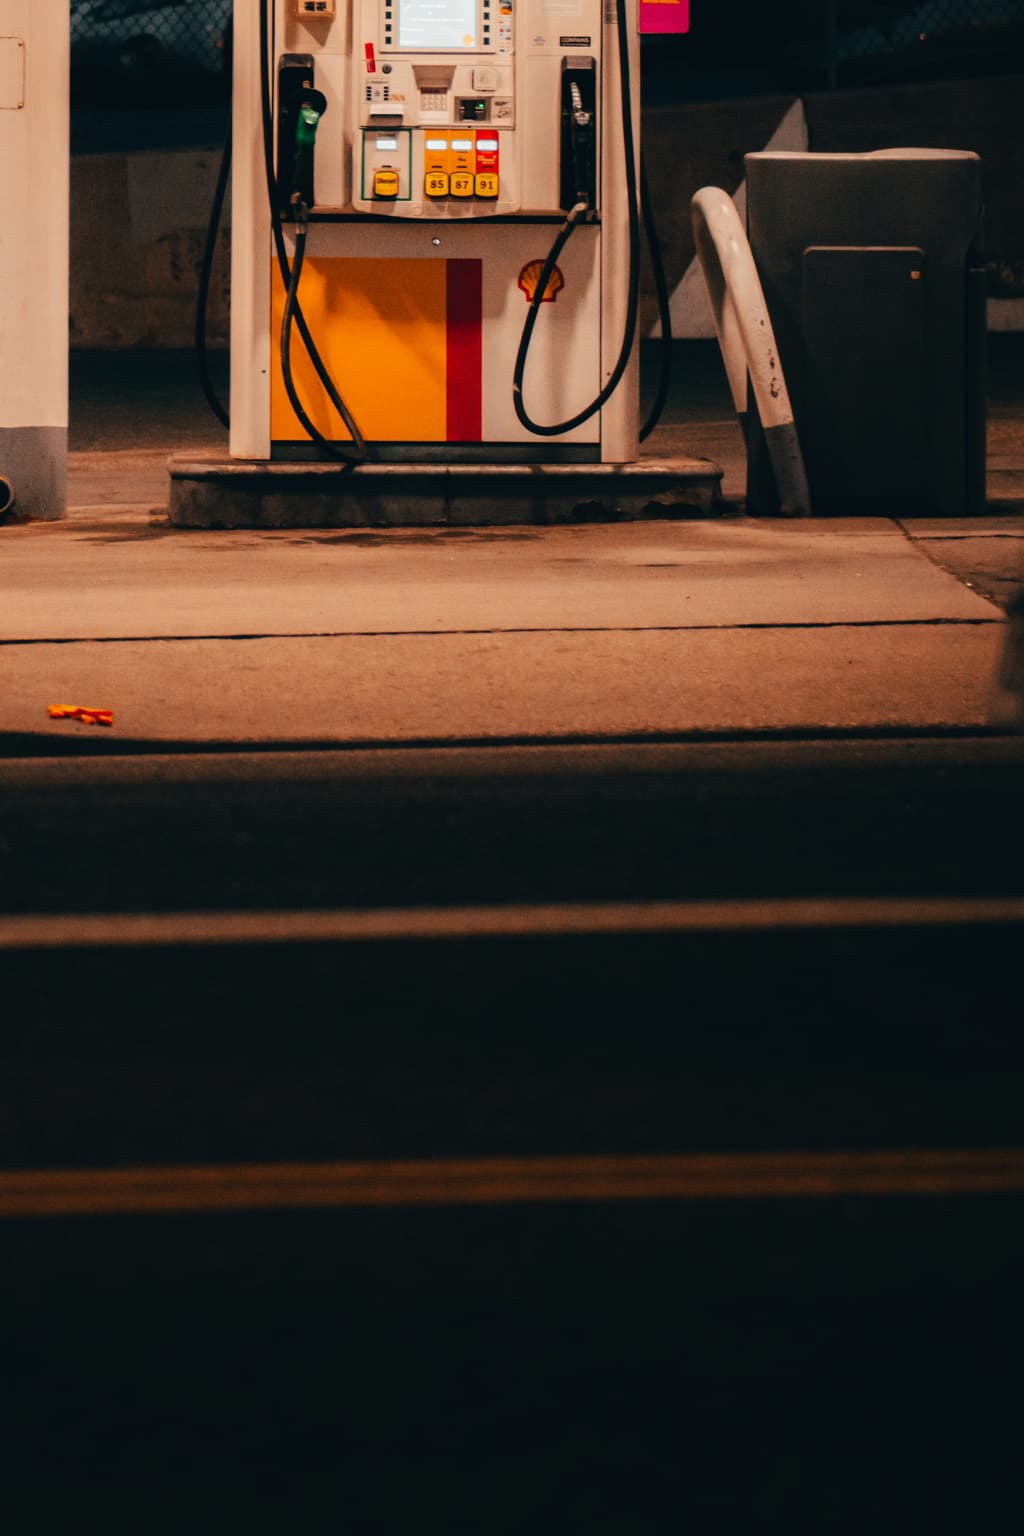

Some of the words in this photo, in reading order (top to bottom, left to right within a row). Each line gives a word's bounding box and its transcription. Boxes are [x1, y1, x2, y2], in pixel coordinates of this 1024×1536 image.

[430, 180, 444, 189] 85
[455, 180, 469, 190] 87
[480, 180, 494, 190] 91
